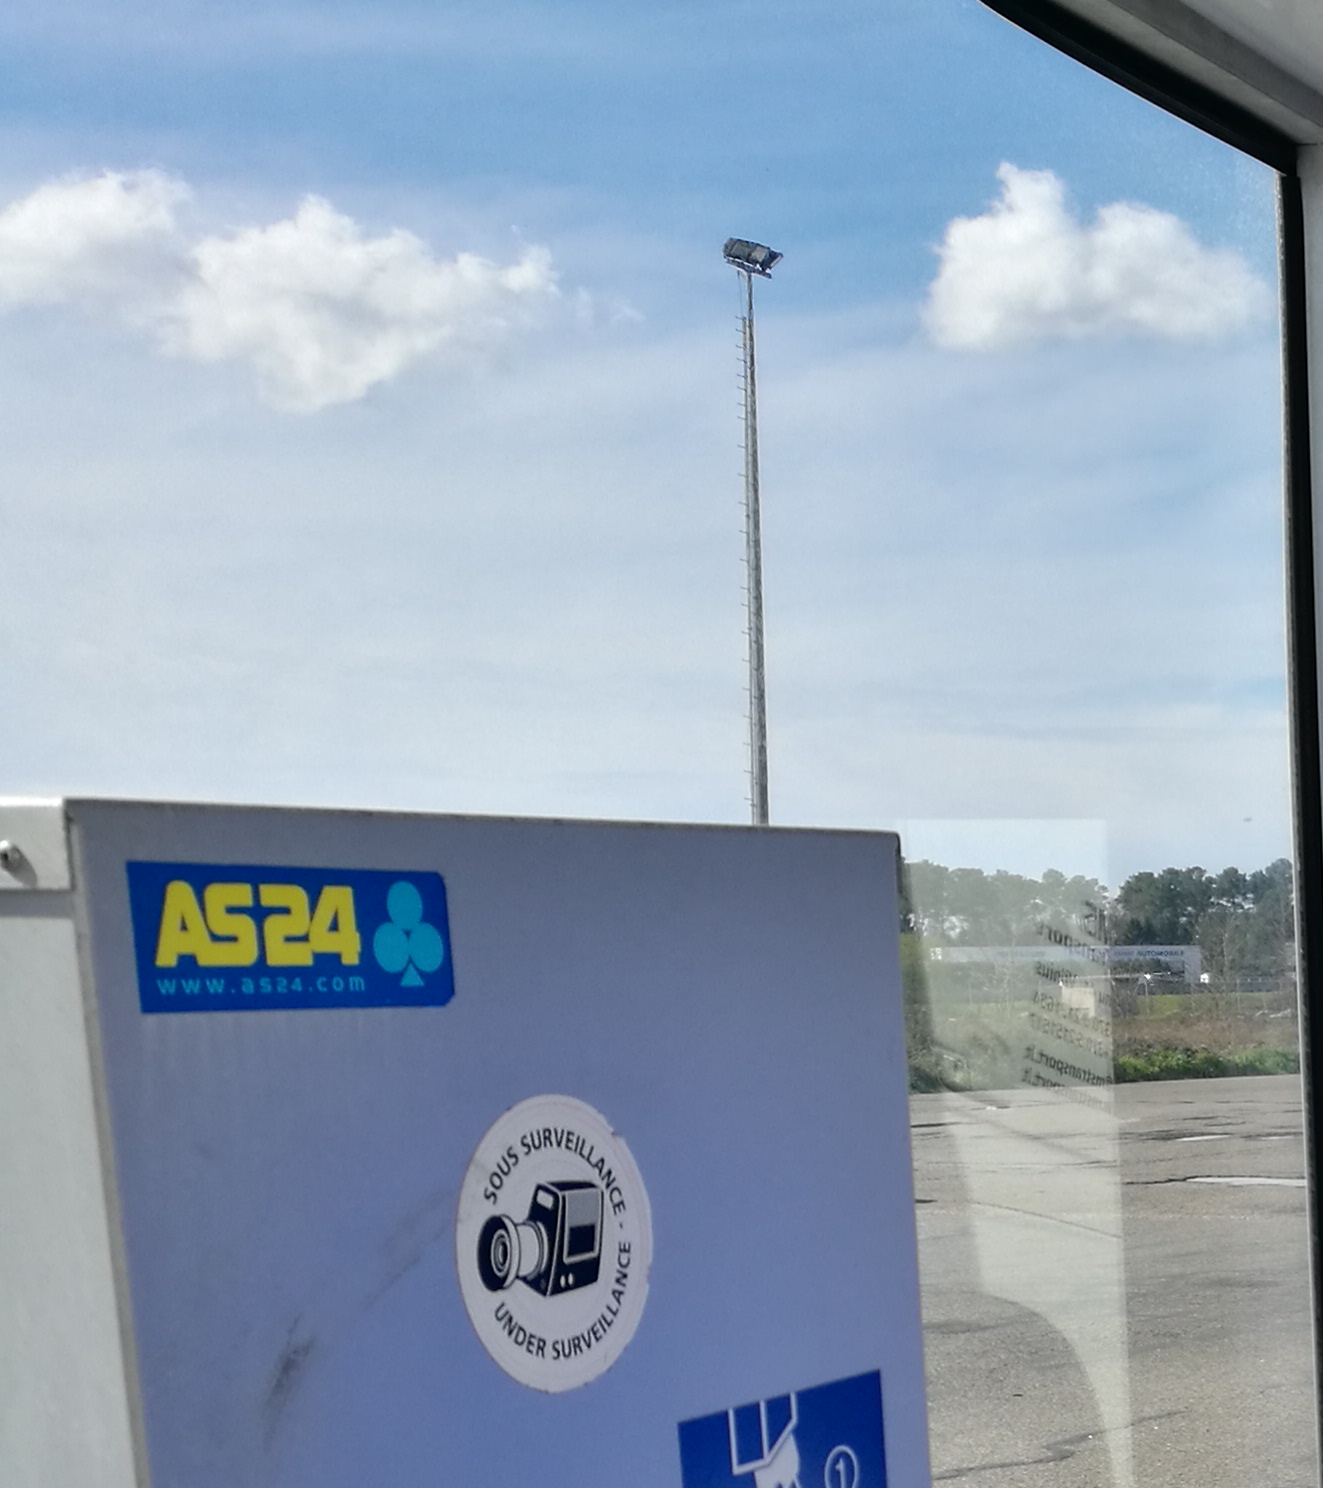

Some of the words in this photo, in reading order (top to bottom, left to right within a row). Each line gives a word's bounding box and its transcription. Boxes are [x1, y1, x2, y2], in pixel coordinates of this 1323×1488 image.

[155, 880, 361, 967] AS24
[156, 975, 366, 996] www.as24.com
[483, 1146, 520, 1205] SOUS
[520, 1127, 626, 1215] SURVEILLANCE
[495, 1302, 547, 1358] UNDER
[551, 1242, 631, 1361] SURVEILLANCE
